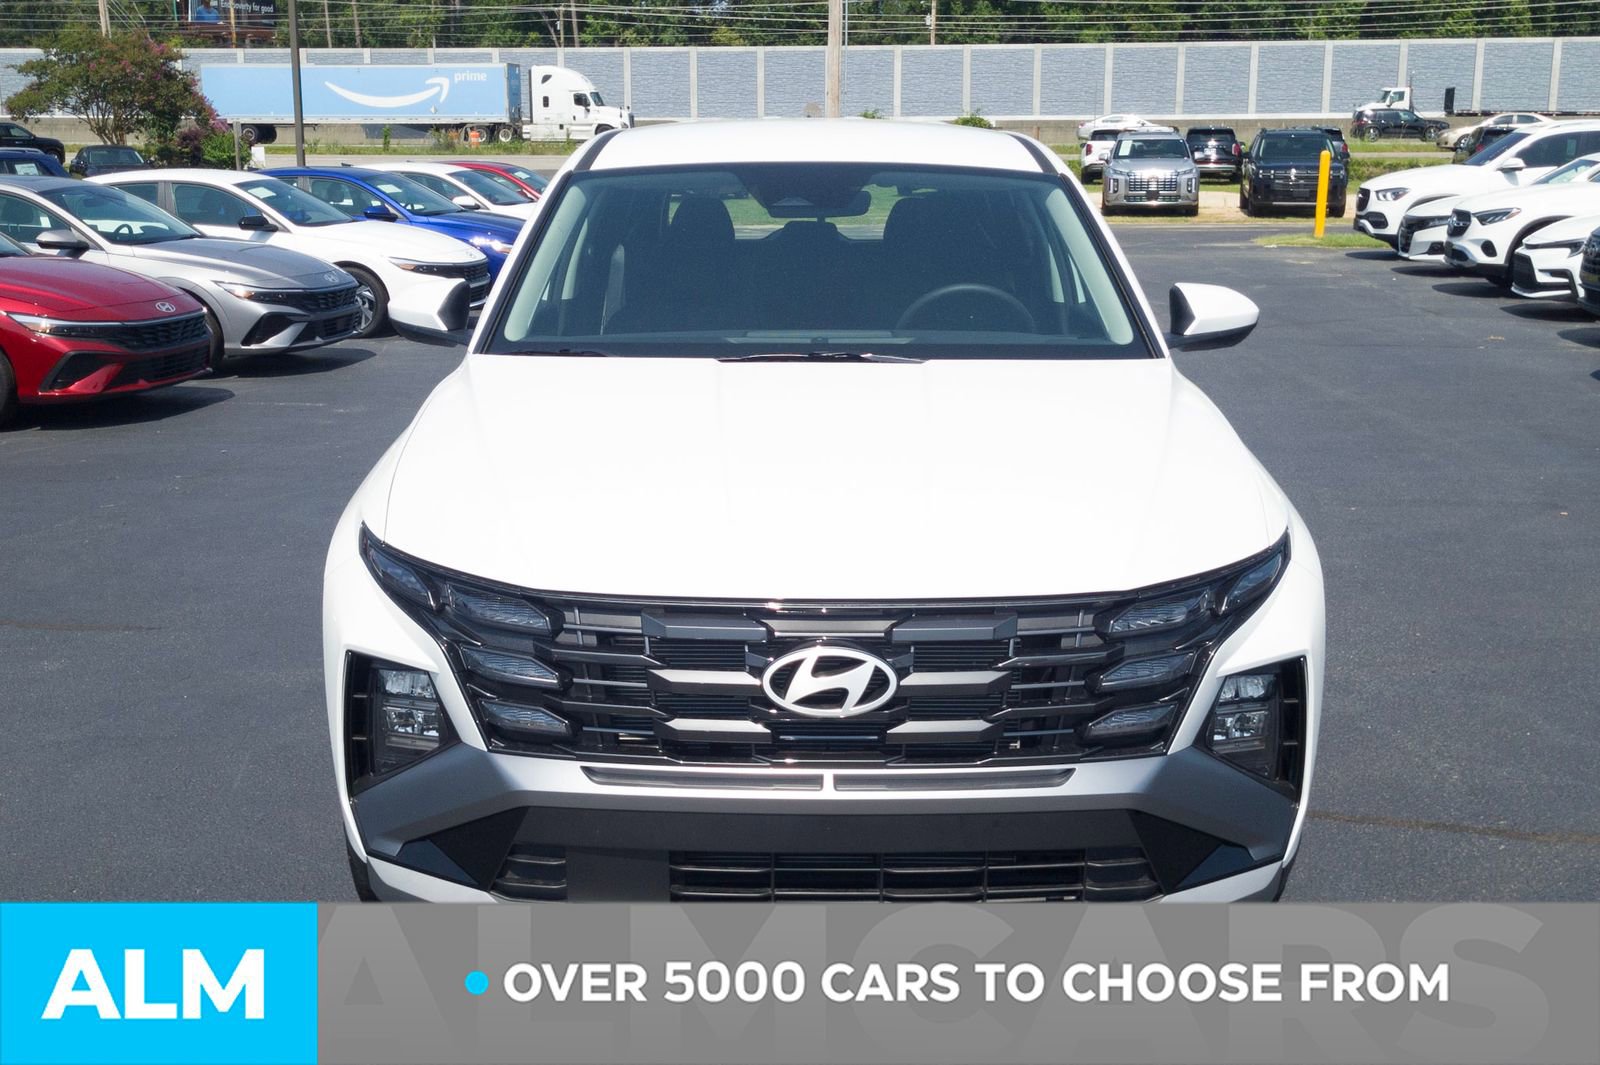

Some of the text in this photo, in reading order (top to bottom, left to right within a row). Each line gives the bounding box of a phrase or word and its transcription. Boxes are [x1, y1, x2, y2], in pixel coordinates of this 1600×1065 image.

[252, 2, 260, 11] for
[261, 4, 273, 14] good
[454, 70, 487, 83] prime
